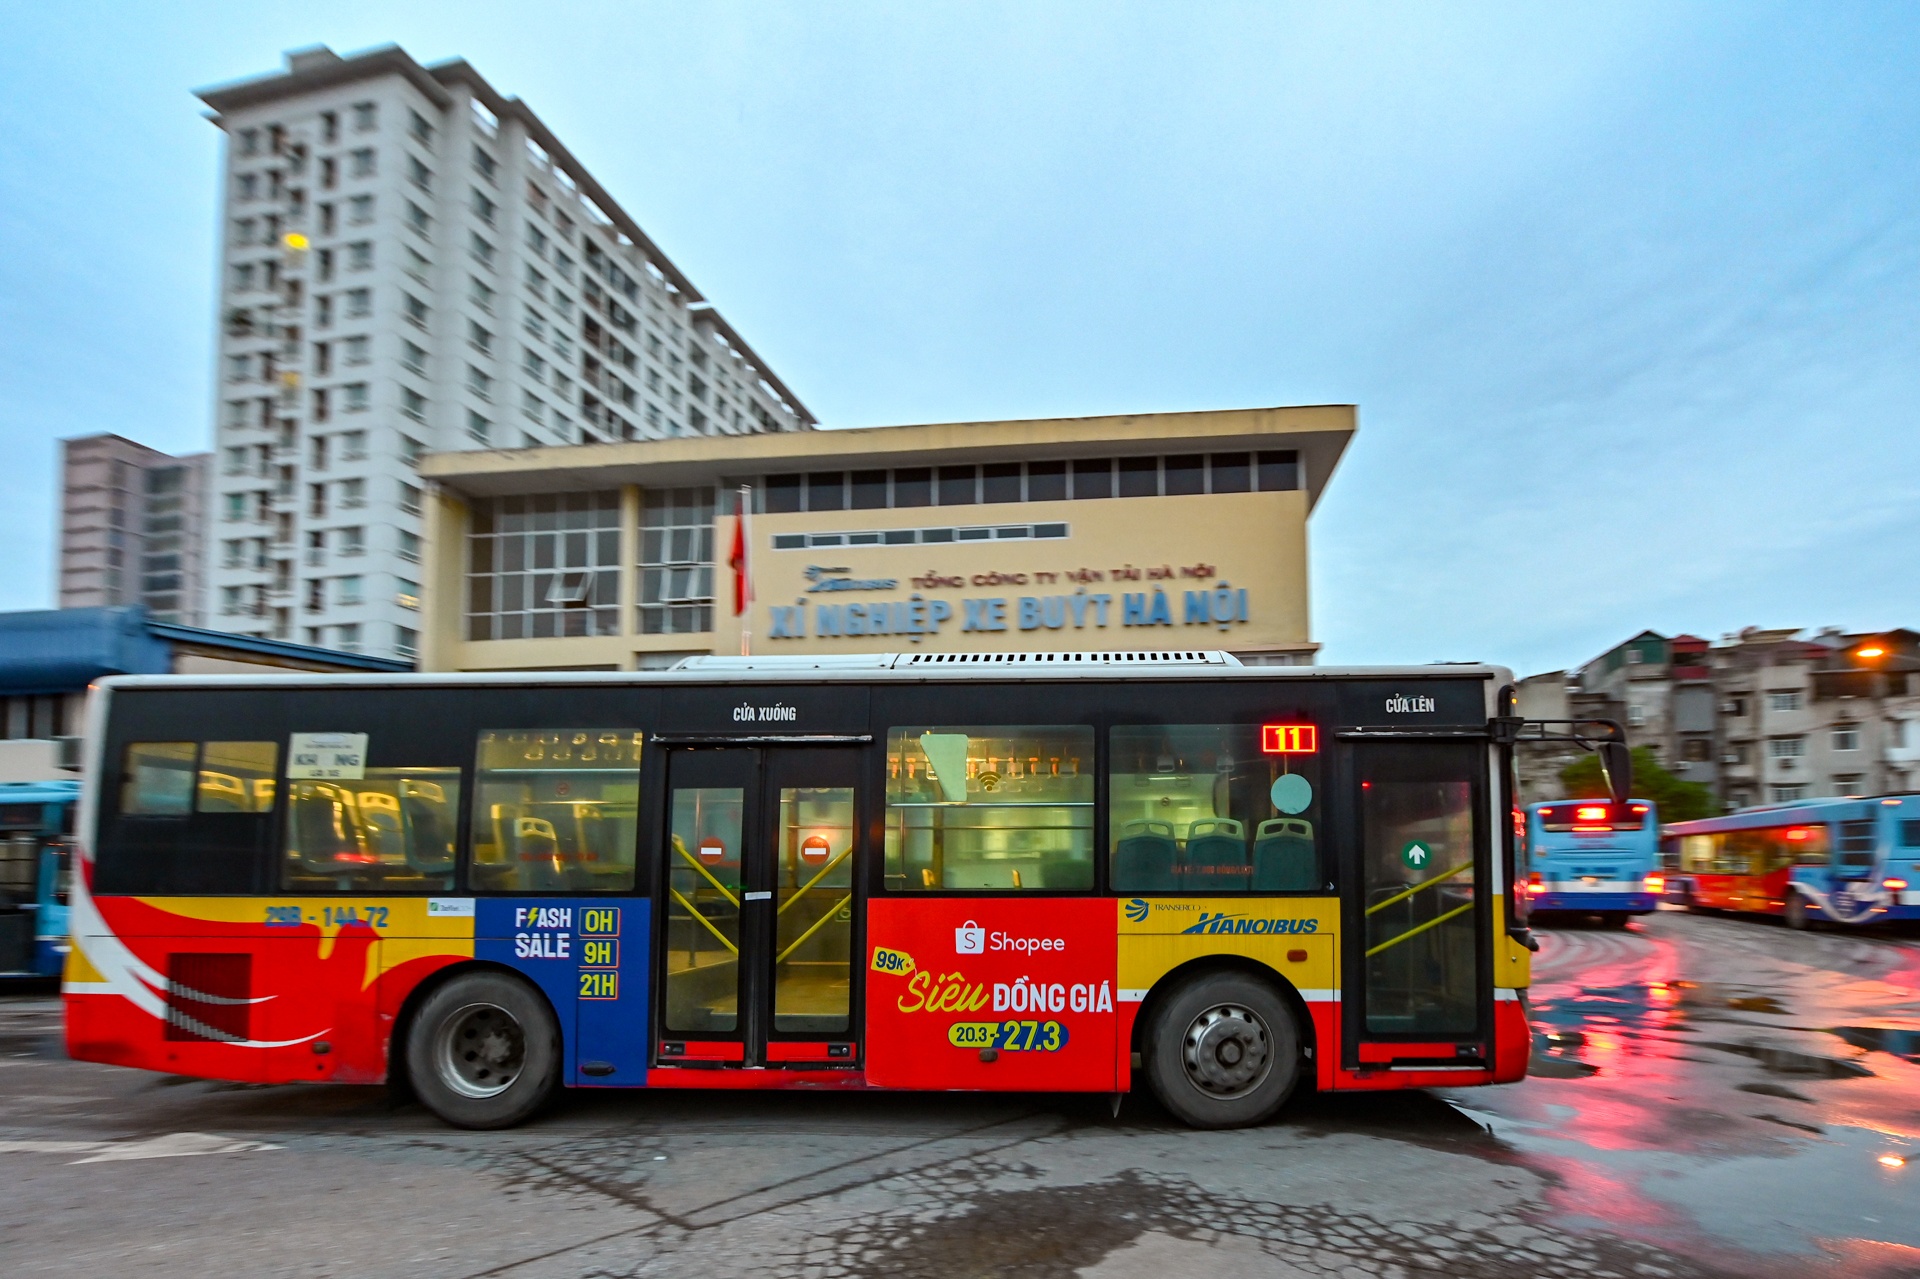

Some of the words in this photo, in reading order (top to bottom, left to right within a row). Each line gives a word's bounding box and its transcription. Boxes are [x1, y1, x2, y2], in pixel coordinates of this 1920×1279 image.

[909, 570, 965, 589] TỔNG
[971, 571, 1028, 586] CÔNG
[1033, 572, 1059, 584] TY
[1065, 568, 1103, 584] VẬN
[1146, 564, 1175, 580] HÀ
[1180, 563, 1216, 581] NỘI
[816, 593, 952, 643] NGHIỆP
[962, 598, 1008, 632] XE
[1018, 586, 1112, 631] BUÝT
[1122, 584, 1172, 627] HÀ
[1184, 580, 1248, 632] NỘI
[733, 702, 755, 721] CỬA
[758, 702, 797, 721] XUỐNG
[1385, 693, 1410, 713] CỬA
[1412, 695, 1435, 713] LÊN
[1275, 727, 1299, 751] 11
[1181, 912, 1319, 934] HANOIBUS
[515, 932, 570, 958] SALE
[584, 942, 611, 964] 9H
[989, 931, 1065, 956] Shopee
[580, 973, 615, 996] 21H
[897, 971, 990, 1013] Siêu
[993, 975, 1065, 1013] ĐỒNG
[1070, 980, 1113, 1013] GIÁ
